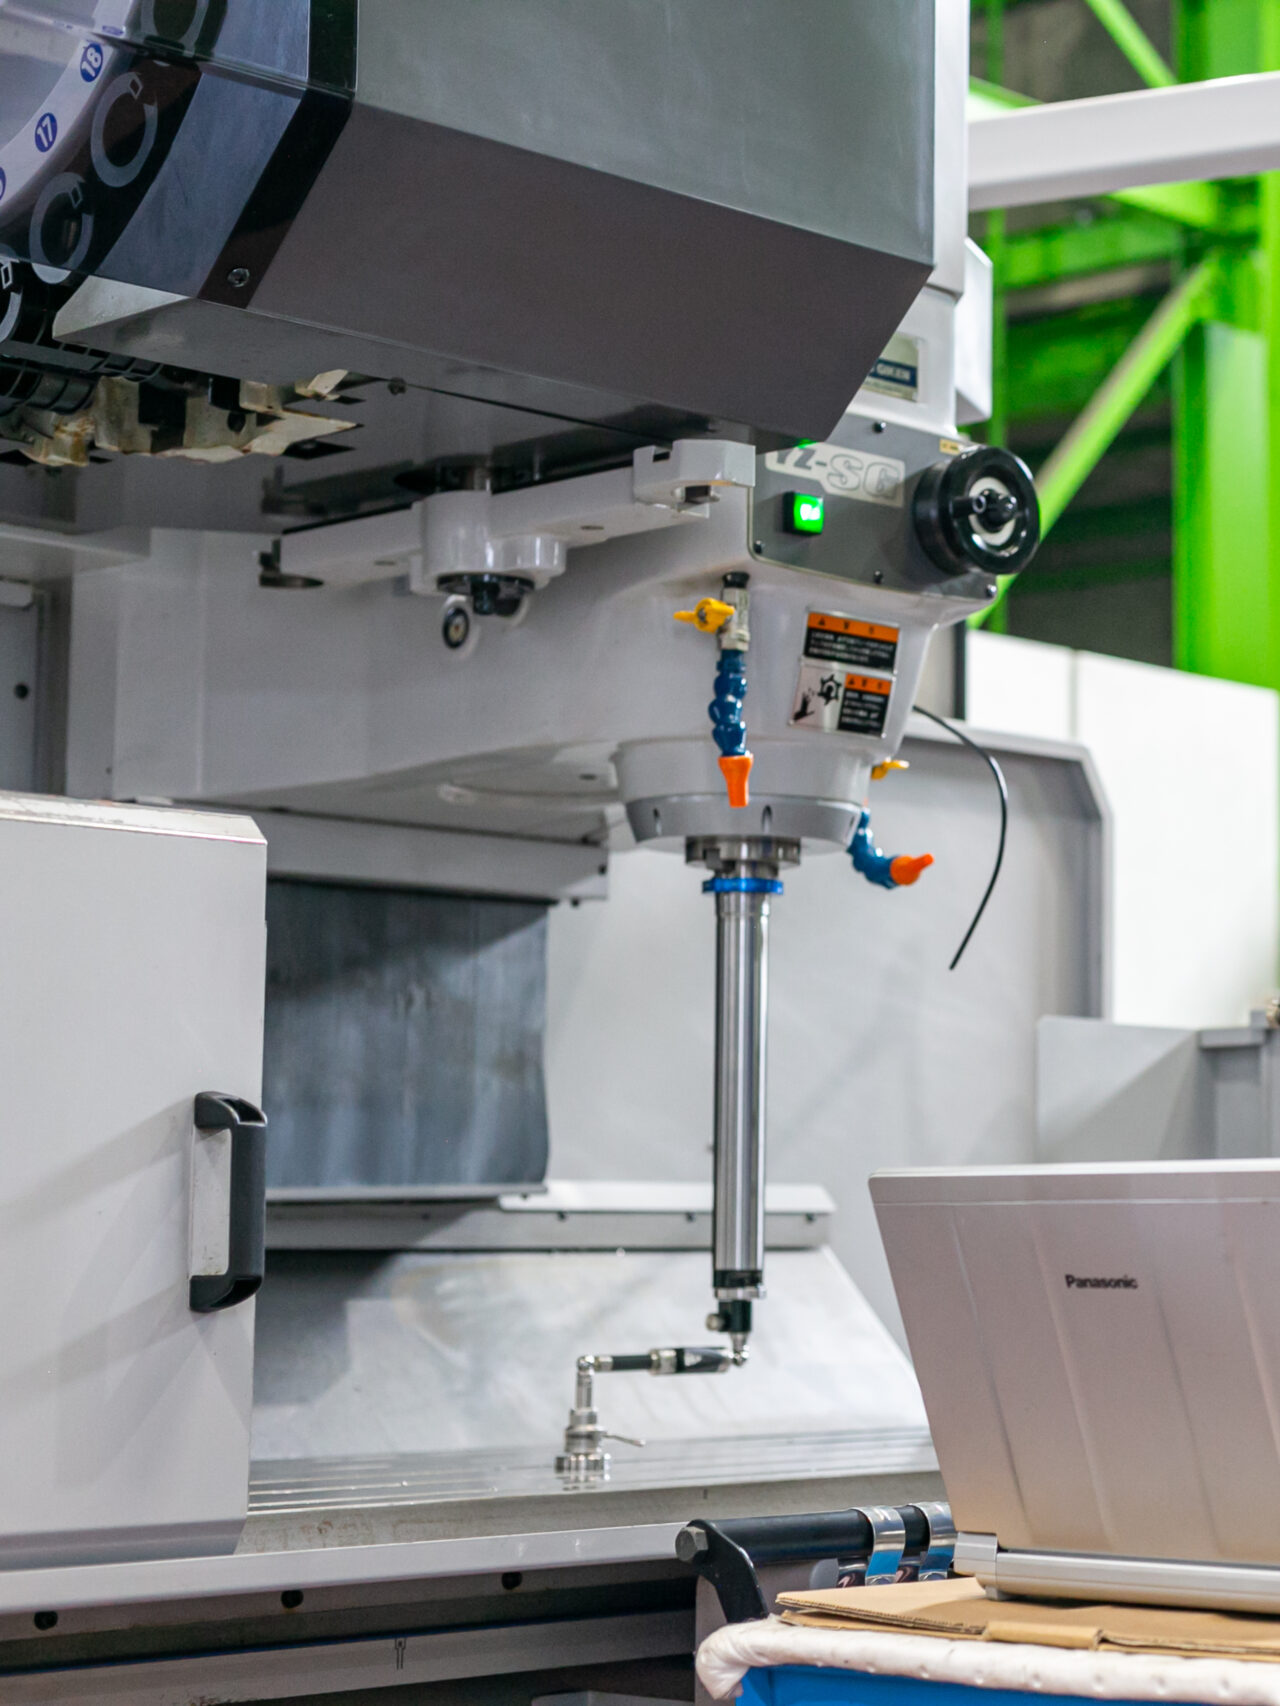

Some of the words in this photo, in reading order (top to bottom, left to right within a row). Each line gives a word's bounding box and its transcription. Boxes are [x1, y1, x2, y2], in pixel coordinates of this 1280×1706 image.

[81, 46, 102, 77] 18
[36, 116, 52, 148] 17
[1065, 1274, 1138, 1289] Panasonic
